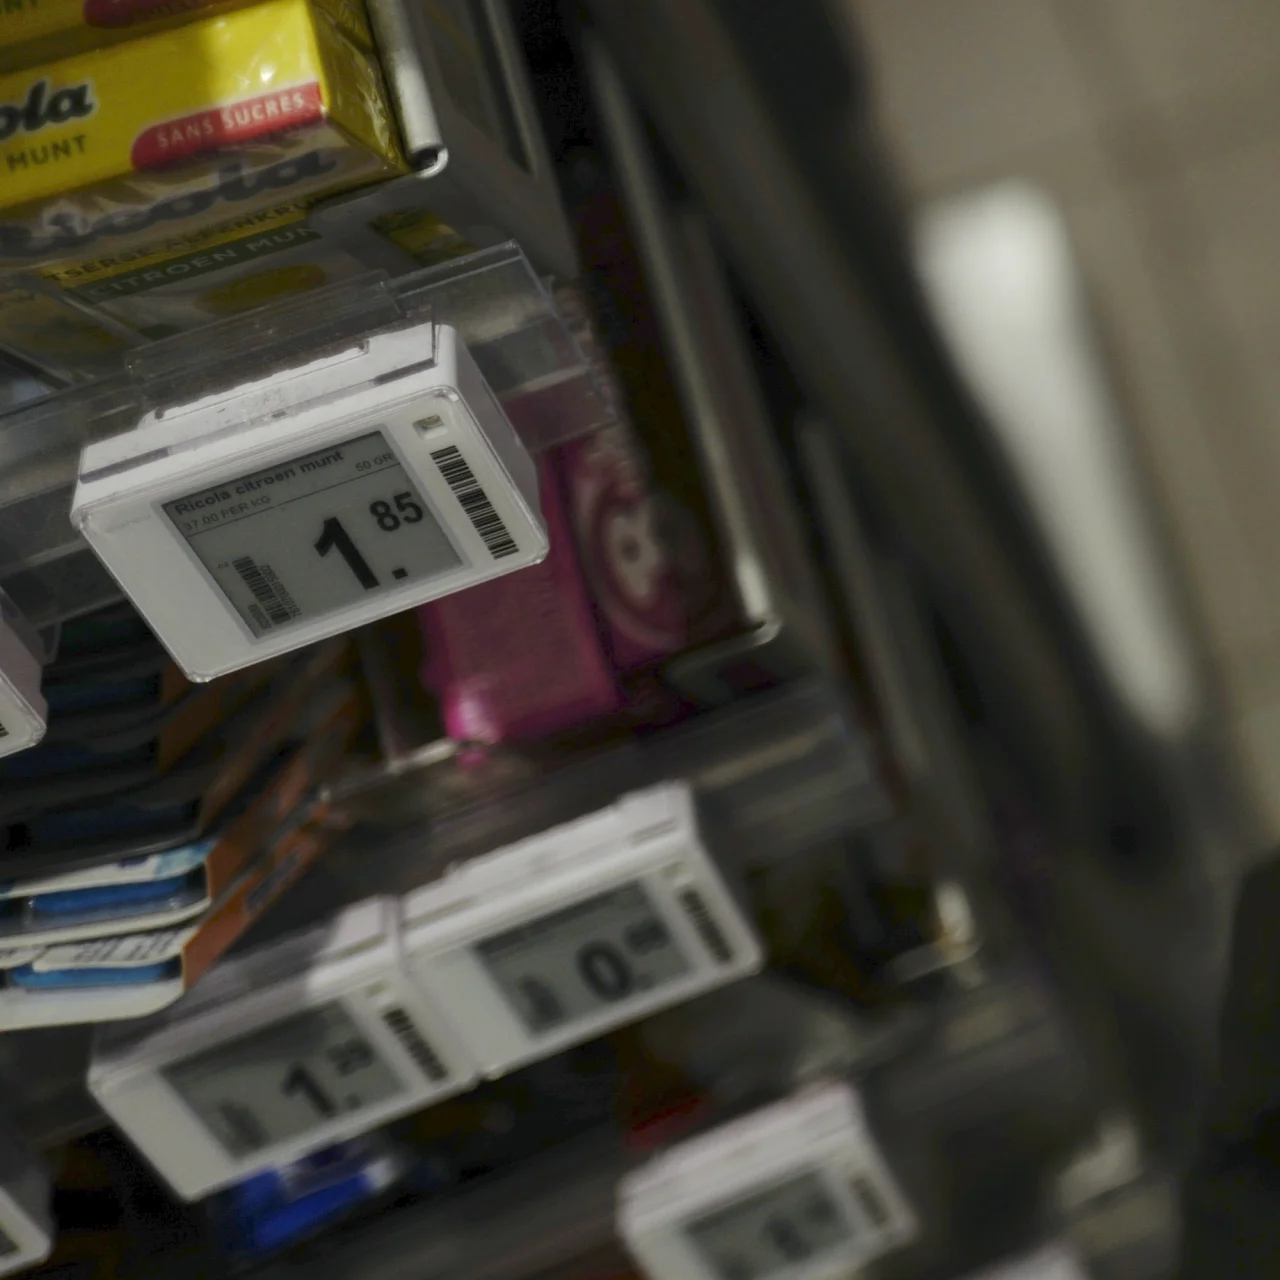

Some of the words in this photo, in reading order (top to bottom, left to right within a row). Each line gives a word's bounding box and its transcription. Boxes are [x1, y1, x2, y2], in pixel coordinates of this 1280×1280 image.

[156, 115, 213, 148] SANS
[222, 91, 305, 130] SUCRES
[5, 133, 87, 172] MUNT
[374, 452, 395, 468] GR
[175, 488, 231, 516] Ricola
[235, 467, 296, 496] citroen
[301, 450, 344, 474] munt
[221, 501, 248, 519] PER
[252, 494, 271, 510] KG
[369, 491, 423, 532] 85
